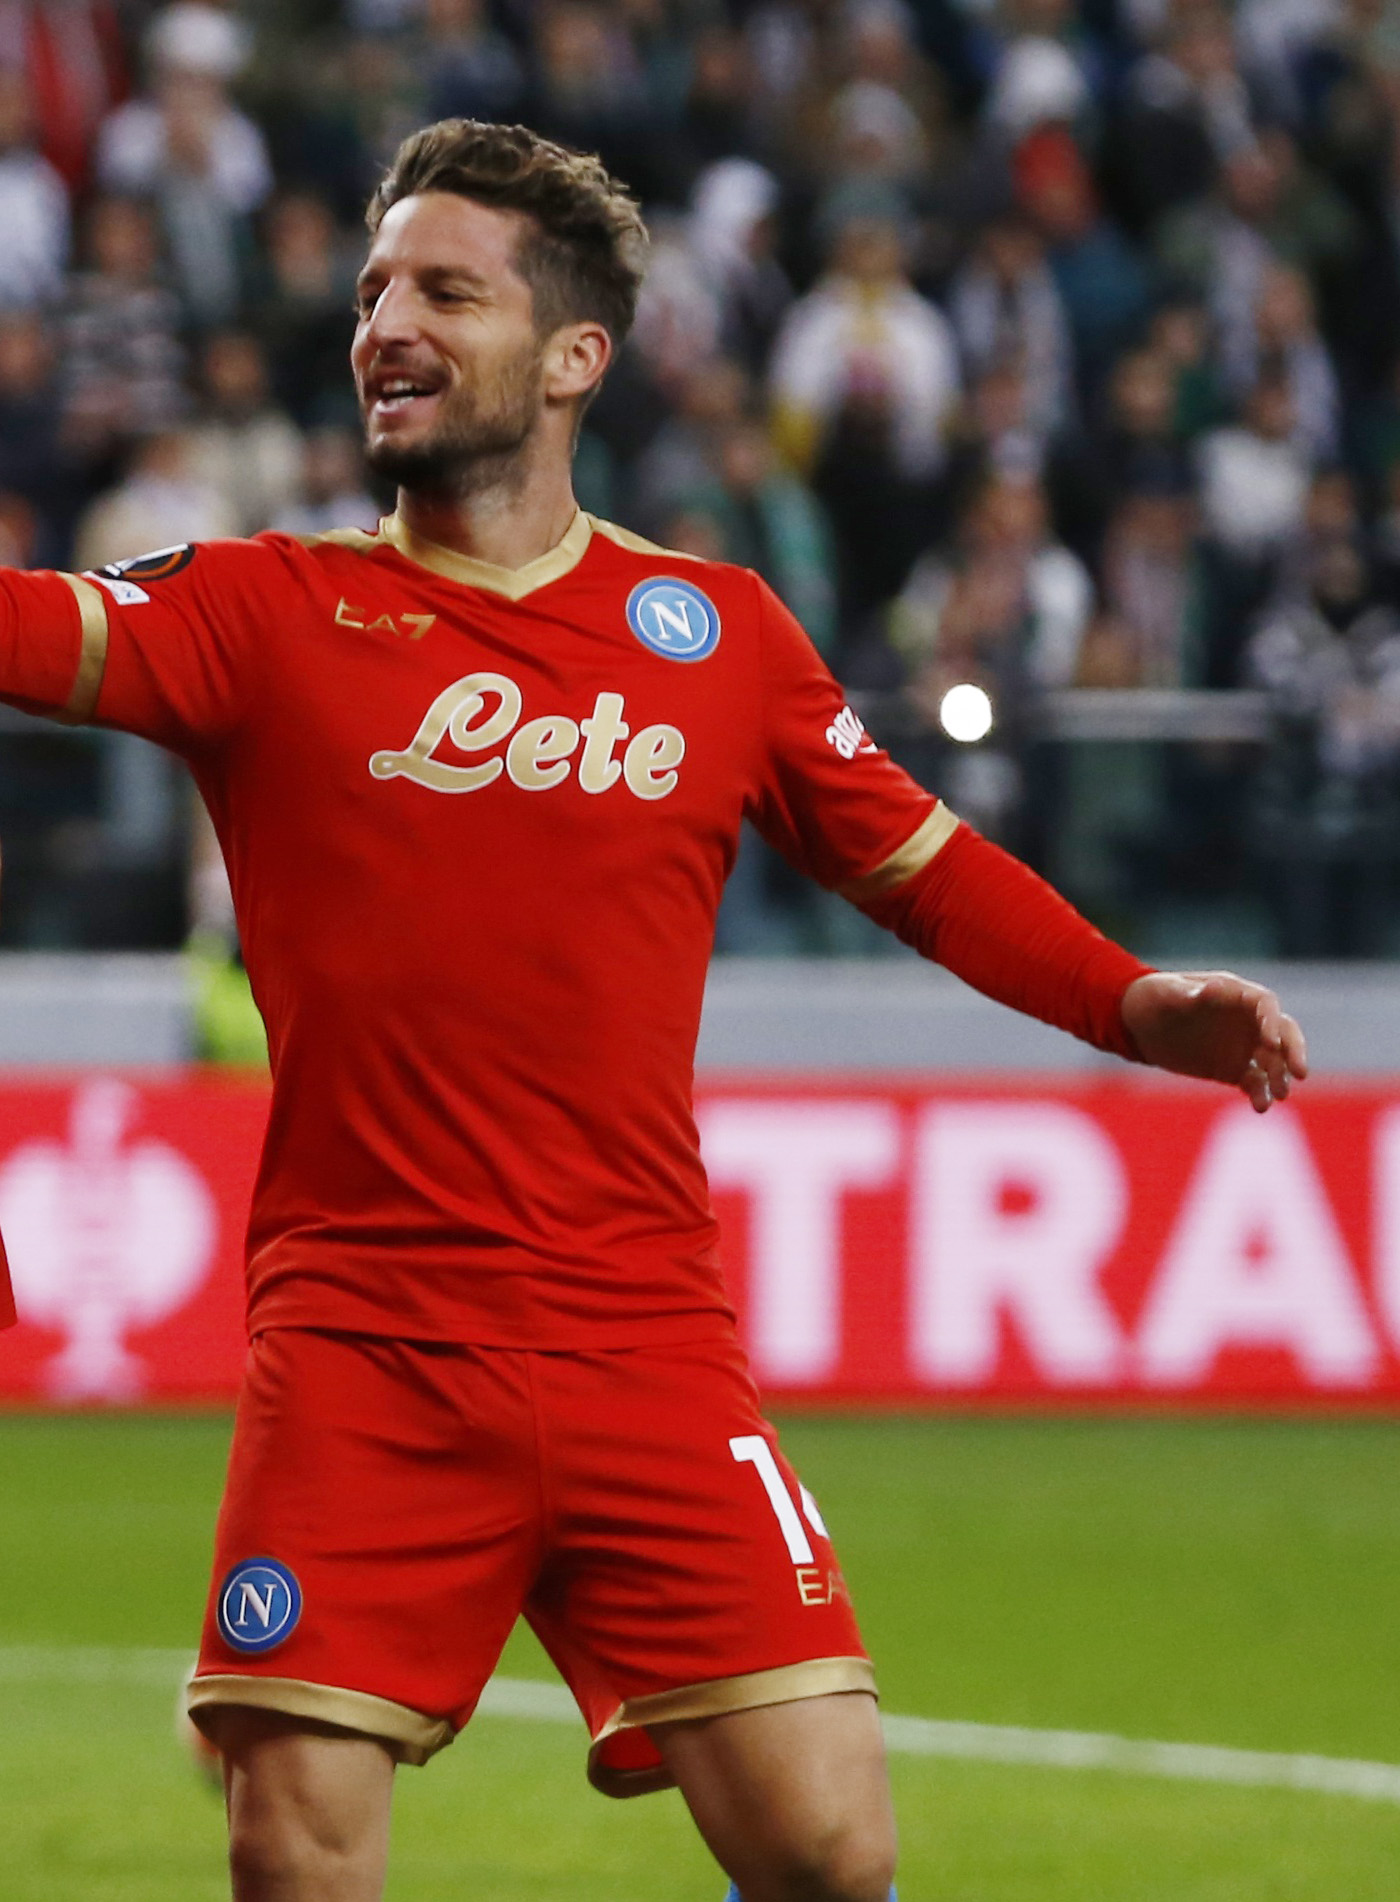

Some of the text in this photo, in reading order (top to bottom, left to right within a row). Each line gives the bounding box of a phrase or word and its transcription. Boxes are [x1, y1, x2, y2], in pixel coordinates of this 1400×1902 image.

[649, 599, 694, 642] N
[369, 671, 687, 800] Lete
[698, 1098, 1400, 1392] TRA
[233, 1582, 278, 1628] N
